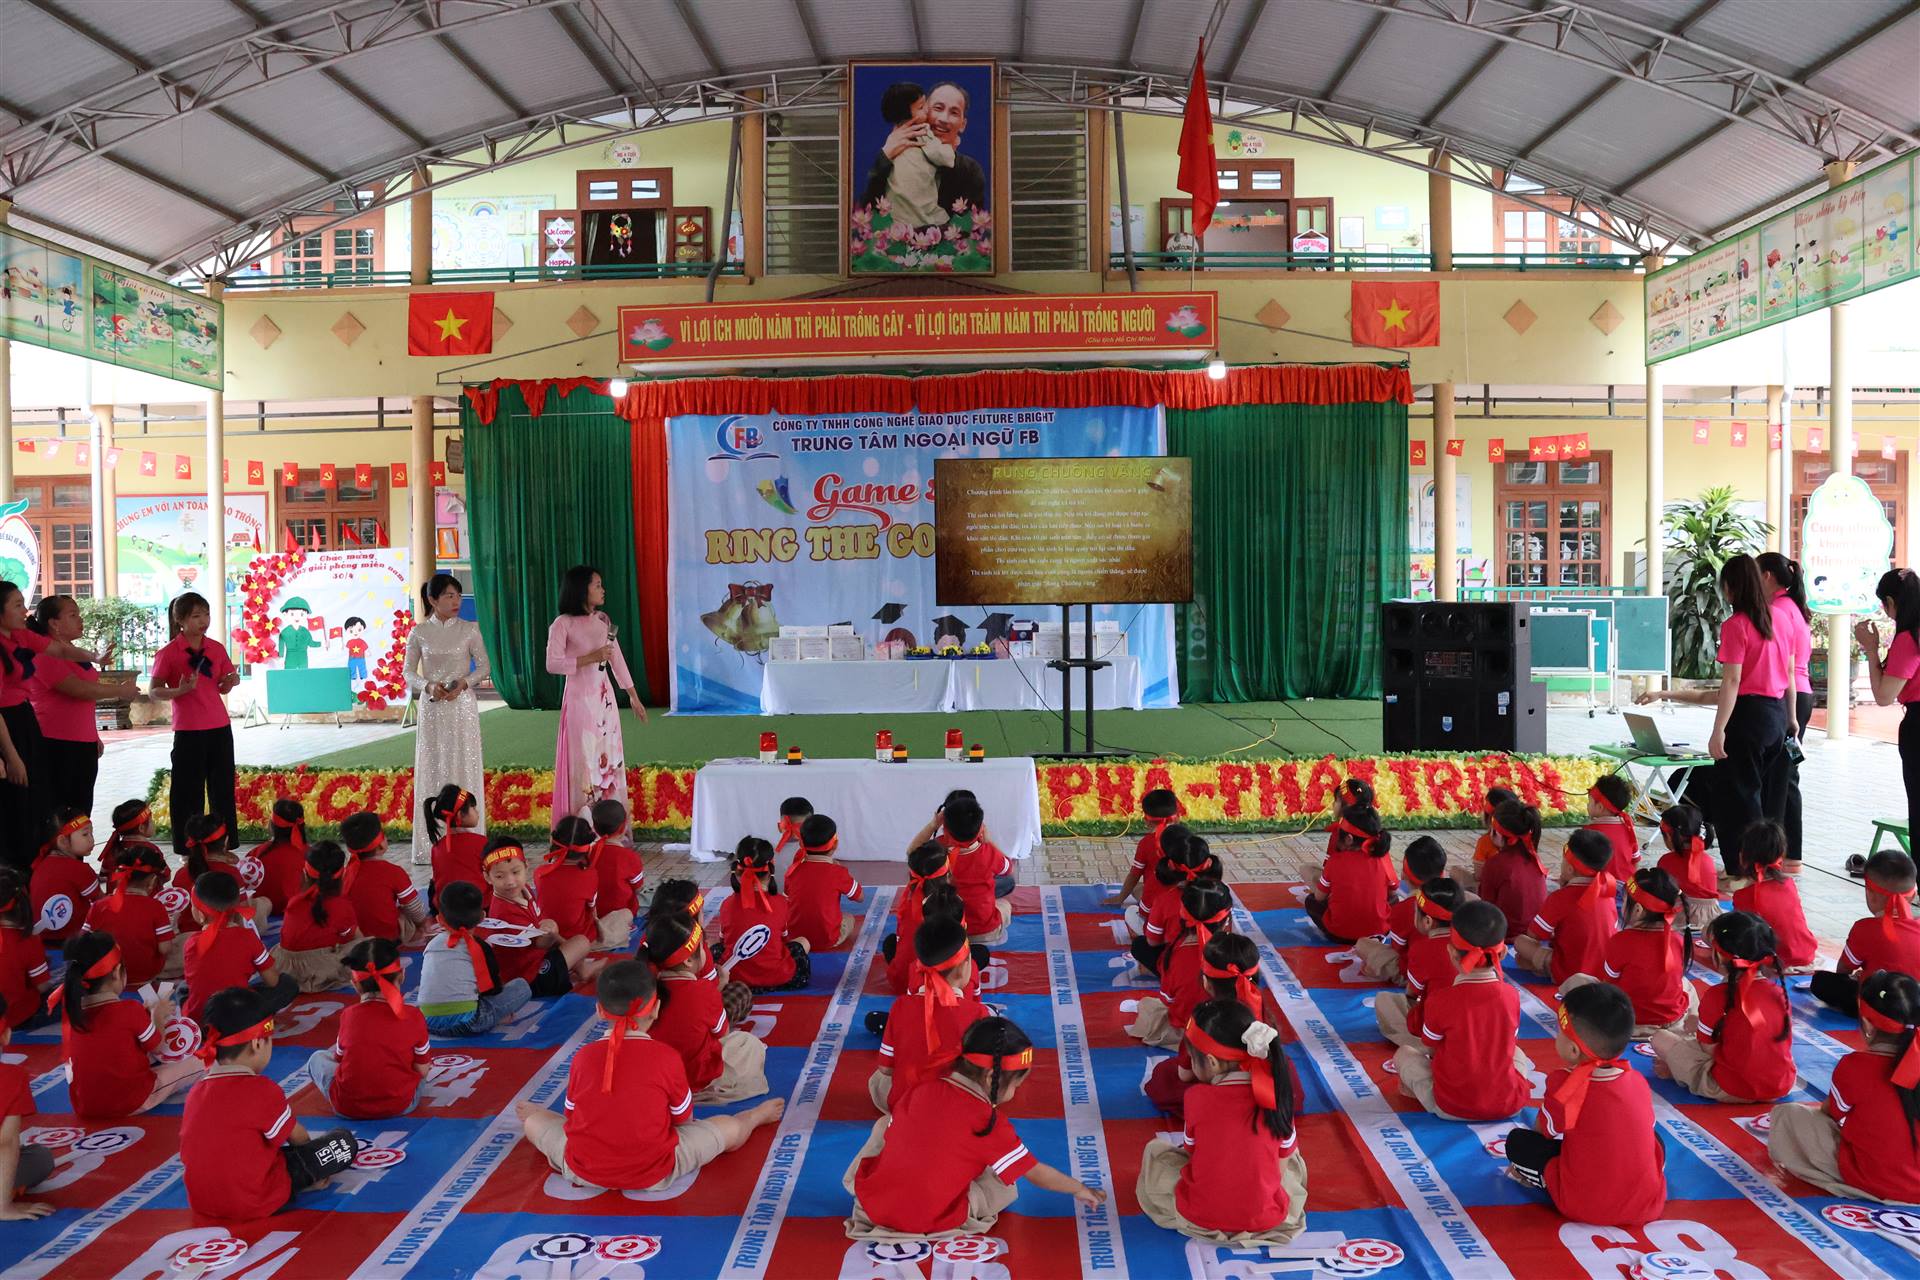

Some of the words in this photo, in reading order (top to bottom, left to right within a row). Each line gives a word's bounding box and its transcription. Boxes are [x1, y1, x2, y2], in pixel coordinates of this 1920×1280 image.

[549, 259, 572, 267] Happy
[680, 318, 691, 343] VÌ
[694, 319, 711, 347] LỢI
[714, 317, 732, 342] ÍCH
[735, 315, 763, 341] MƯỜI
[766, 315, 791, 340] NĂM
[795, 313, 812, 339] THÌ
[815, 308, 840, 338] PHẢI
[844, 307, 880, 338] TRỒNG
[883, 310, 904, 337] CÂY
[915, 309, 926, 336] VÌ
[929, 310, 946, 340] LỢI
[949, 305, 967, 335] ÍCH
[970, 307, 1001, 335] TRĂM
[1004, 306, 1029, 334] NĂM
[1033, 305, 1050, 333] THÌ
[1053, 303, 1078, 333] PHẢI
[1082, 303, 1118, 333] TRỒNG
[1121, 304, 1155, 333] NGƯỜI
[773, 419, 802, 431] CÔNG
[806, 420, 818, 430] TY
[822, 418, 850, 430] TNHH
[854, 416, 883, 428] CÔNG
[947, 414, 968, 426] DỤC
[973, 413, 1014, 425] FUTURE
[1018, 411, 1054, 423] BRIGHT
[791, 436, 853, 452] TRUNG
[859, 432, 897, 450] TÂM
[904, 432, 966, 450] NGOẠI
[973, 428, 1014, 446] NGỮ
[1020, 430, 1039, 444] FB
[141, 507, 154, 518] EM
[172, 500, 184, 511] AN
[806, 472, 920, 526] Game
[705, 528, 800, 564] RING
[805, 524, 880, 561] THE
[887, 523, 936, 558] GO
[784, 1133, 801, 1150] FB
[760, 1161, 795, 1201] NGOẠI
[1401, 1156, 1442, 1195] NGOẠI
[382, 1221, 431, 1266] TRUNG
[424, 1195, 455, 1225] TÂM
[443, 1162, 488, 1199] NGOẠI
[499, 1132, 516, 1153] FB
[754, 1200, 777, 1230] TÂM
[1424, 1193, 1458, 1219] TÂM
[40, 1213, 101, 1261] TRUNG
[733, 1228, 768, 1270] TRUNG
[1092, 1225, 1116, 1270] TRUNG
[1444, 1219, 1488, 1261] TRUNG
